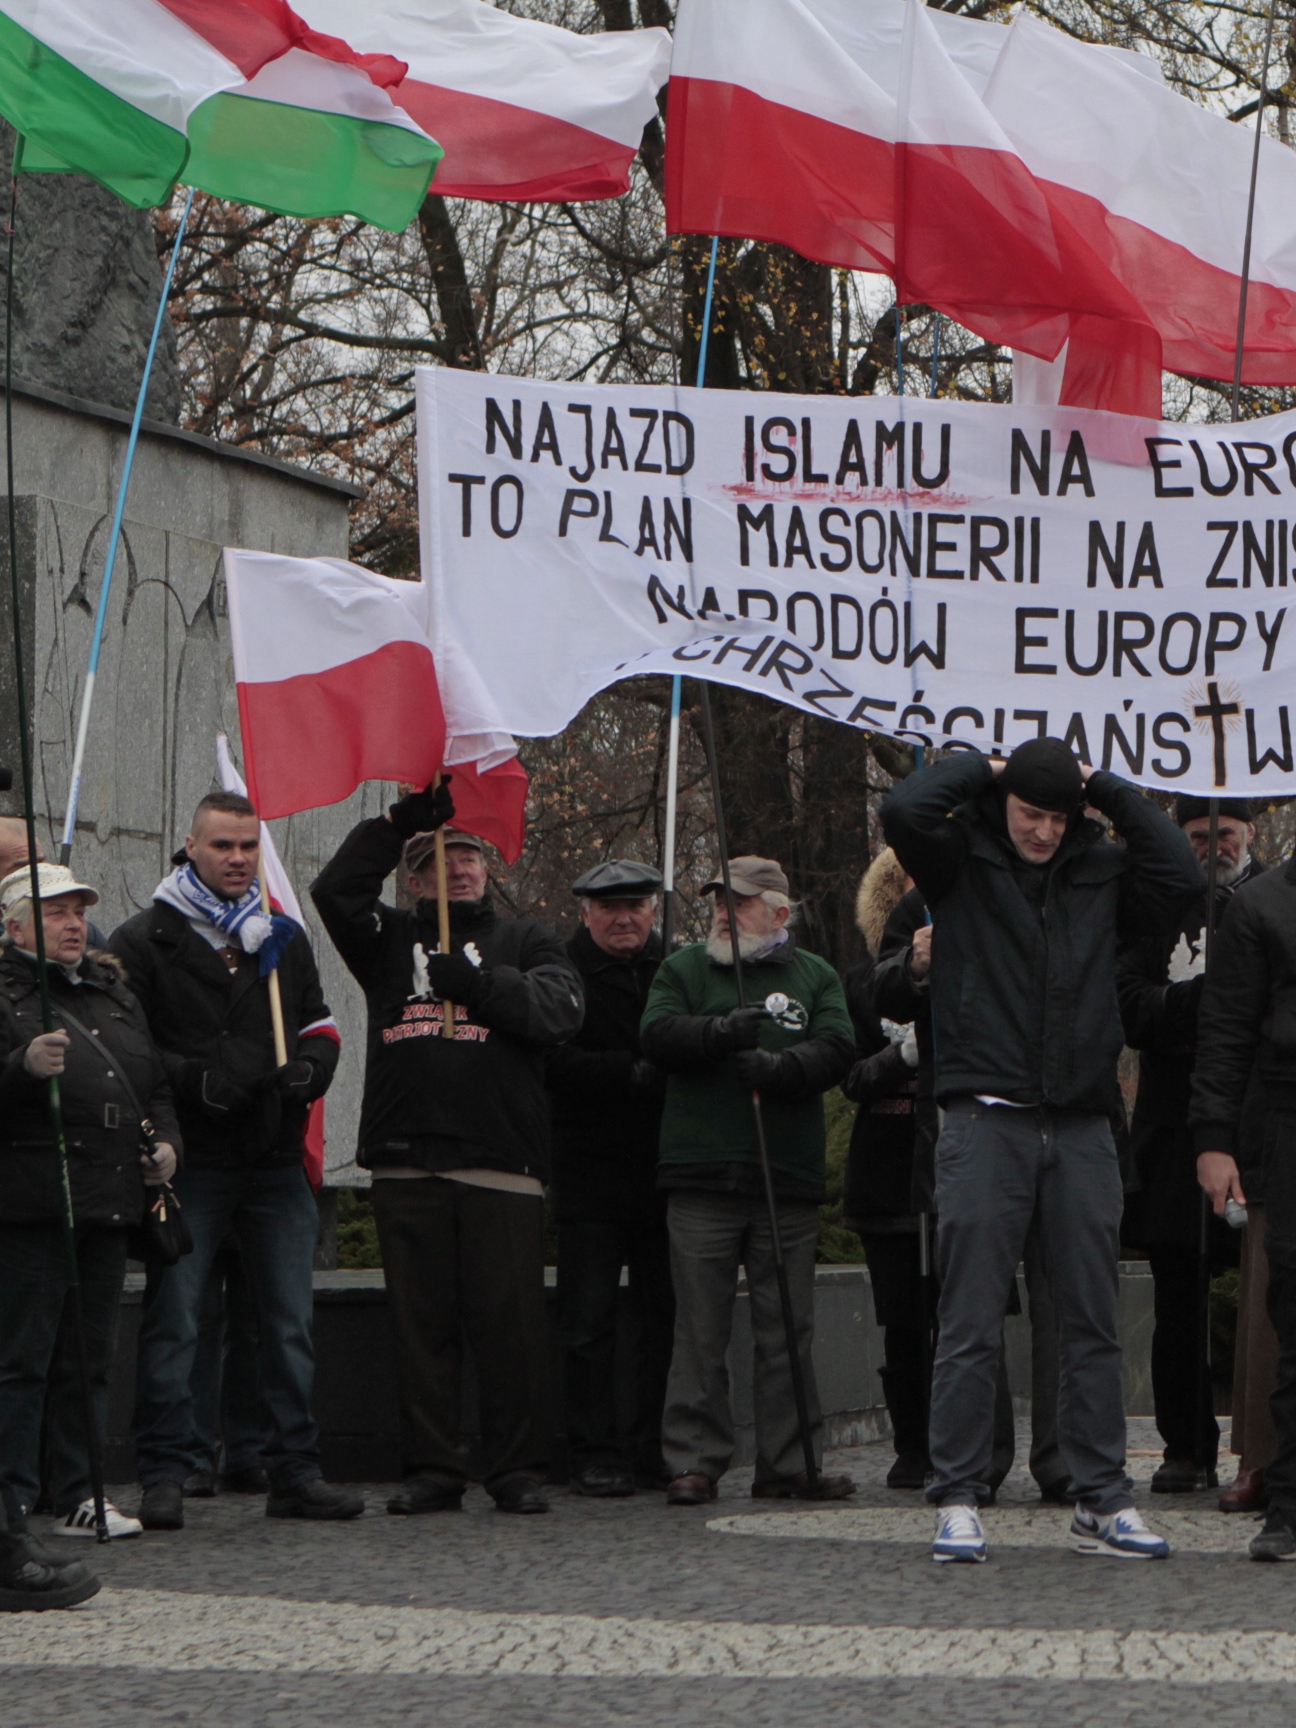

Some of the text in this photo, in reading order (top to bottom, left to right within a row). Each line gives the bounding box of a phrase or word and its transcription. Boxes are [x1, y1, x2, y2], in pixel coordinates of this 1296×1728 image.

[485, 396, 695, 483] NAJAZD
[744, 415, 951, 490] ISLAMU
[1009, 428, 1096, 498] NA
[448, 472, 525, 540] TO
[558, 488, 695, 564] PLAN
[736, 503, 1042, 583] MASONERII
[1086, 520, 1165, 589] NA
[1014, 606, 1288, 678] EUROPY
[382, 1021, 490, 1044] PATRIOTCZNY
[402, 1003, 468, 1021] ZWIĄEK
